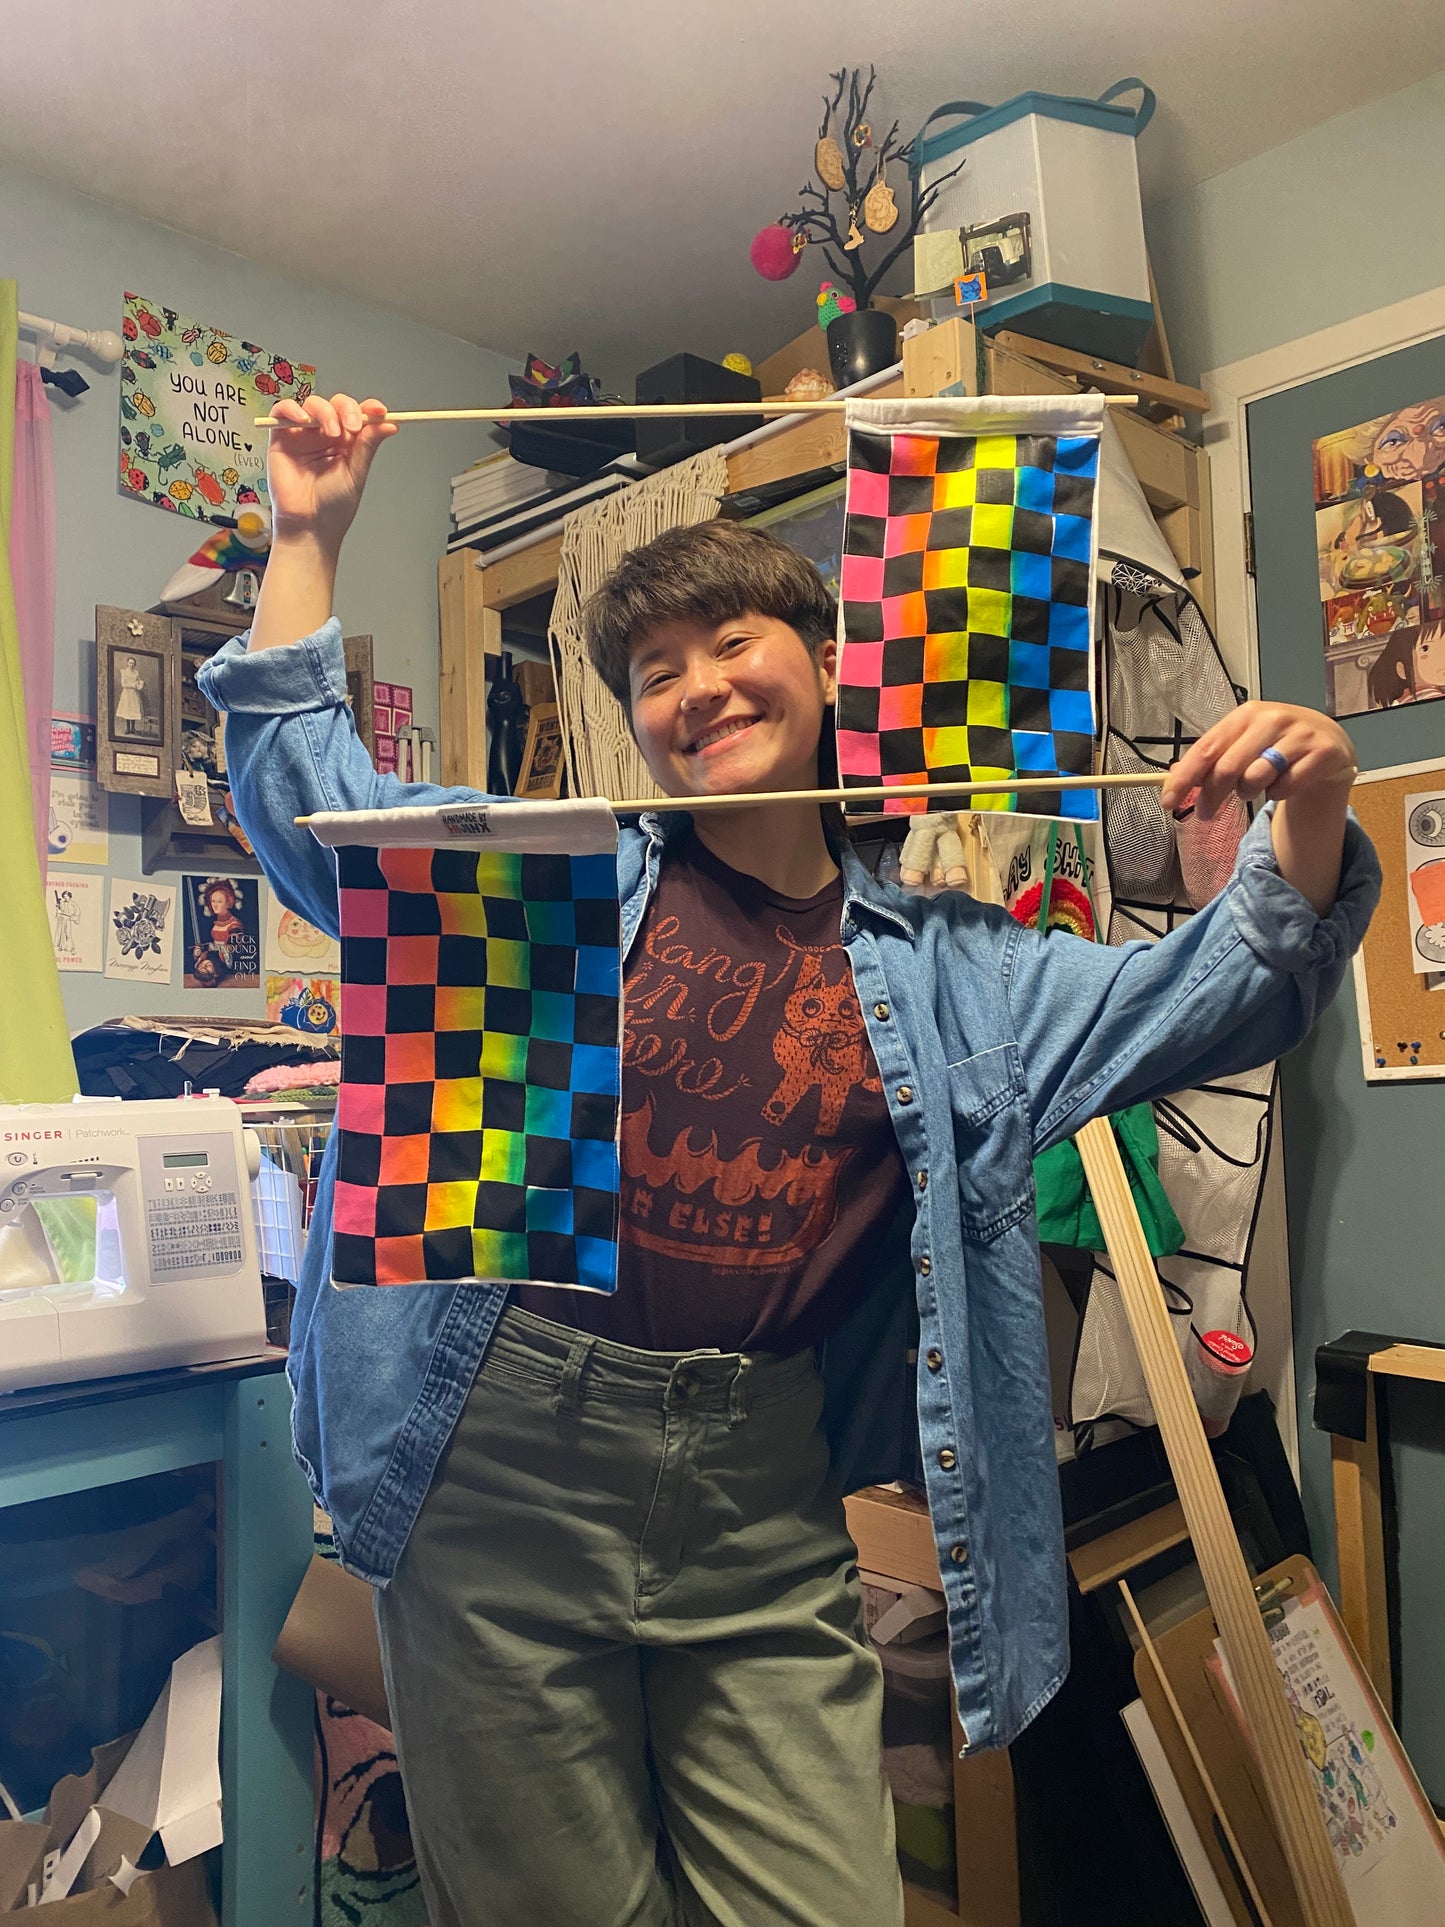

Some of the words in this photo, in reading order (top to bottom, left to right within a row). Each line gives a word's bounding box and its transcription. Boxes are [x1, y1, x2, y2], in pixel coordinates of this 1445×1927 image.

[170, 372, 208, 396] YOU
[215, 382, 247, 406] ARE
[193, 401, 229, 425] NOT
[182, 421, 242, 451] ALONE
[234, 452, 265, 472] (EVER)
[441, 812, 478, 825] HANDMADE
[479, 811, 487, 823] BY
[1003, 844, 1032, 901] AY
[230, 934, 256, 944] FUCK
[234, 960, 257, 971] FIND
[234, 971, 255, 983] OUT
[622, 1010, 752, 1101] ere
[4, 1130, 63, 1142] SINGER
[75, 1128, 125, 1139] Patchwork
[668, 1200, 773, 1243] ELSE!
